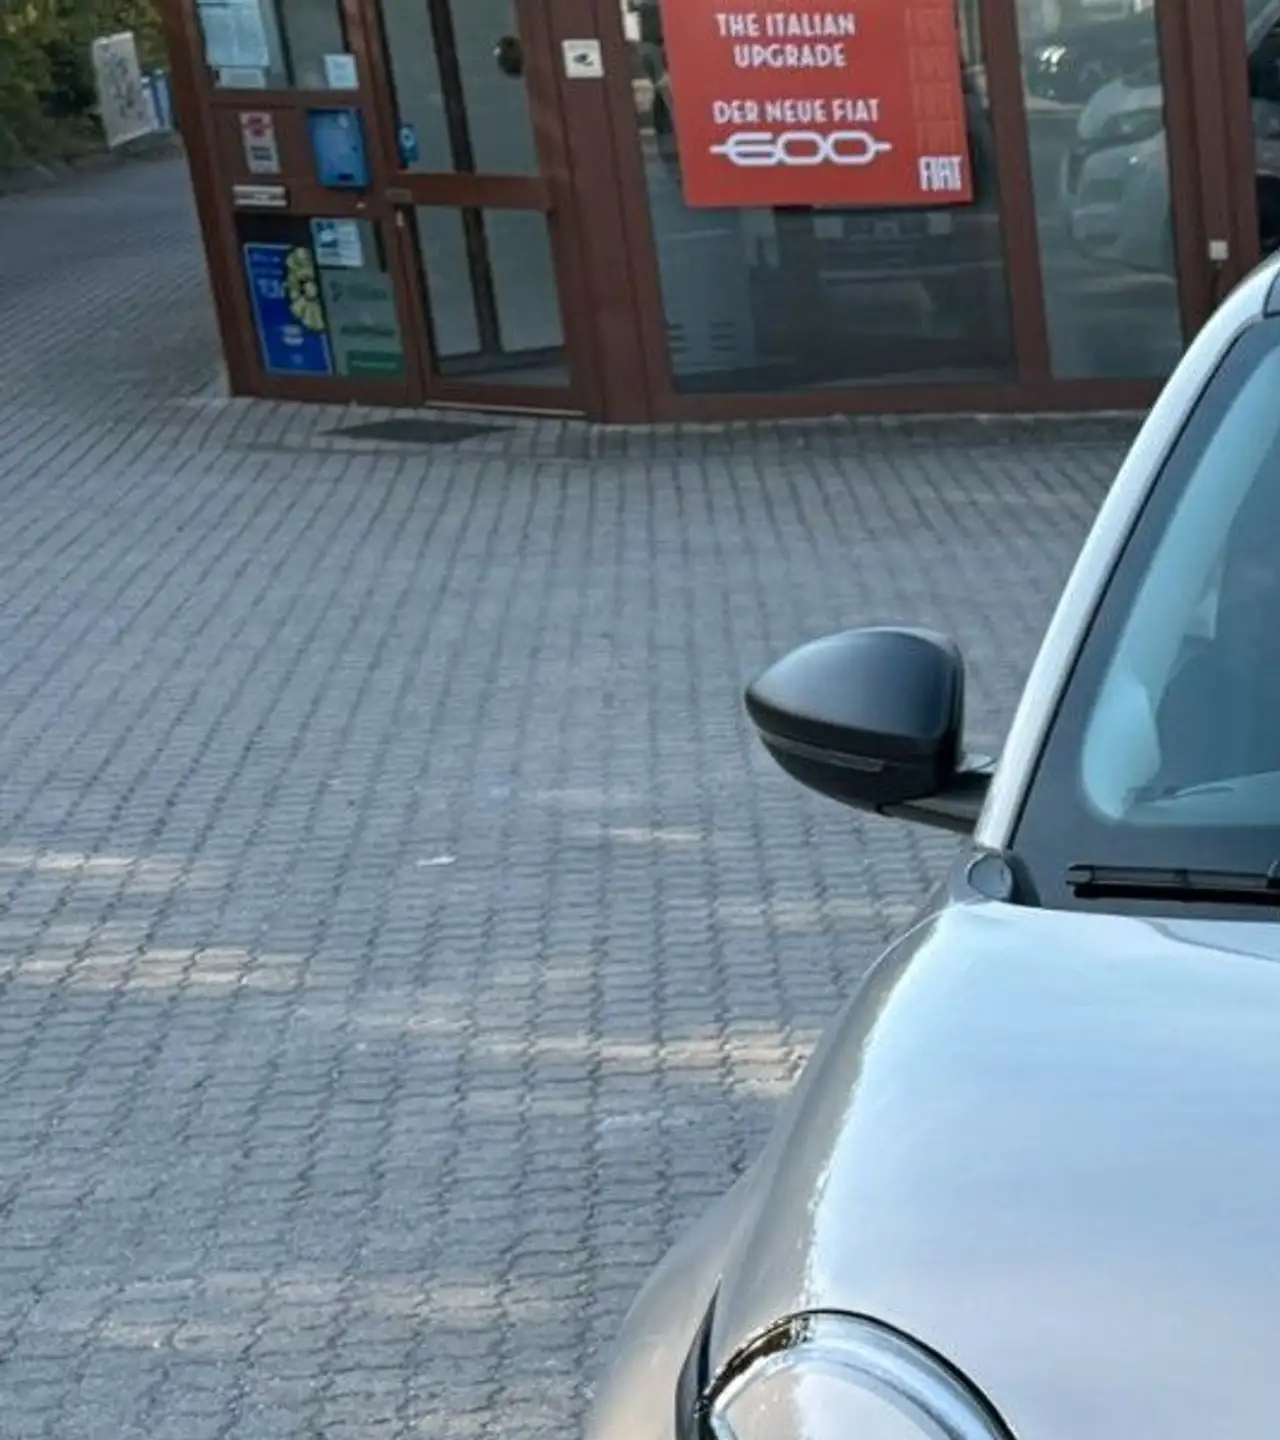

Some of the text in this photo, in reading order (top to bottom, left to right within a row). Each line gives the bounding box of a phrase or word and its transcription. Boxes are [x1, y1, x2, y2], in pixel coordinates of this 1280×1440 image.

[716, 13, 856, 37] THE ITALIAN
[733, 44, 847, 68] UPGRADE
[712, 98, 880, 124] DER NEUE FIAT
[710, 131, 892, 166] 600
[919, 156, 962, 192] FIAT
